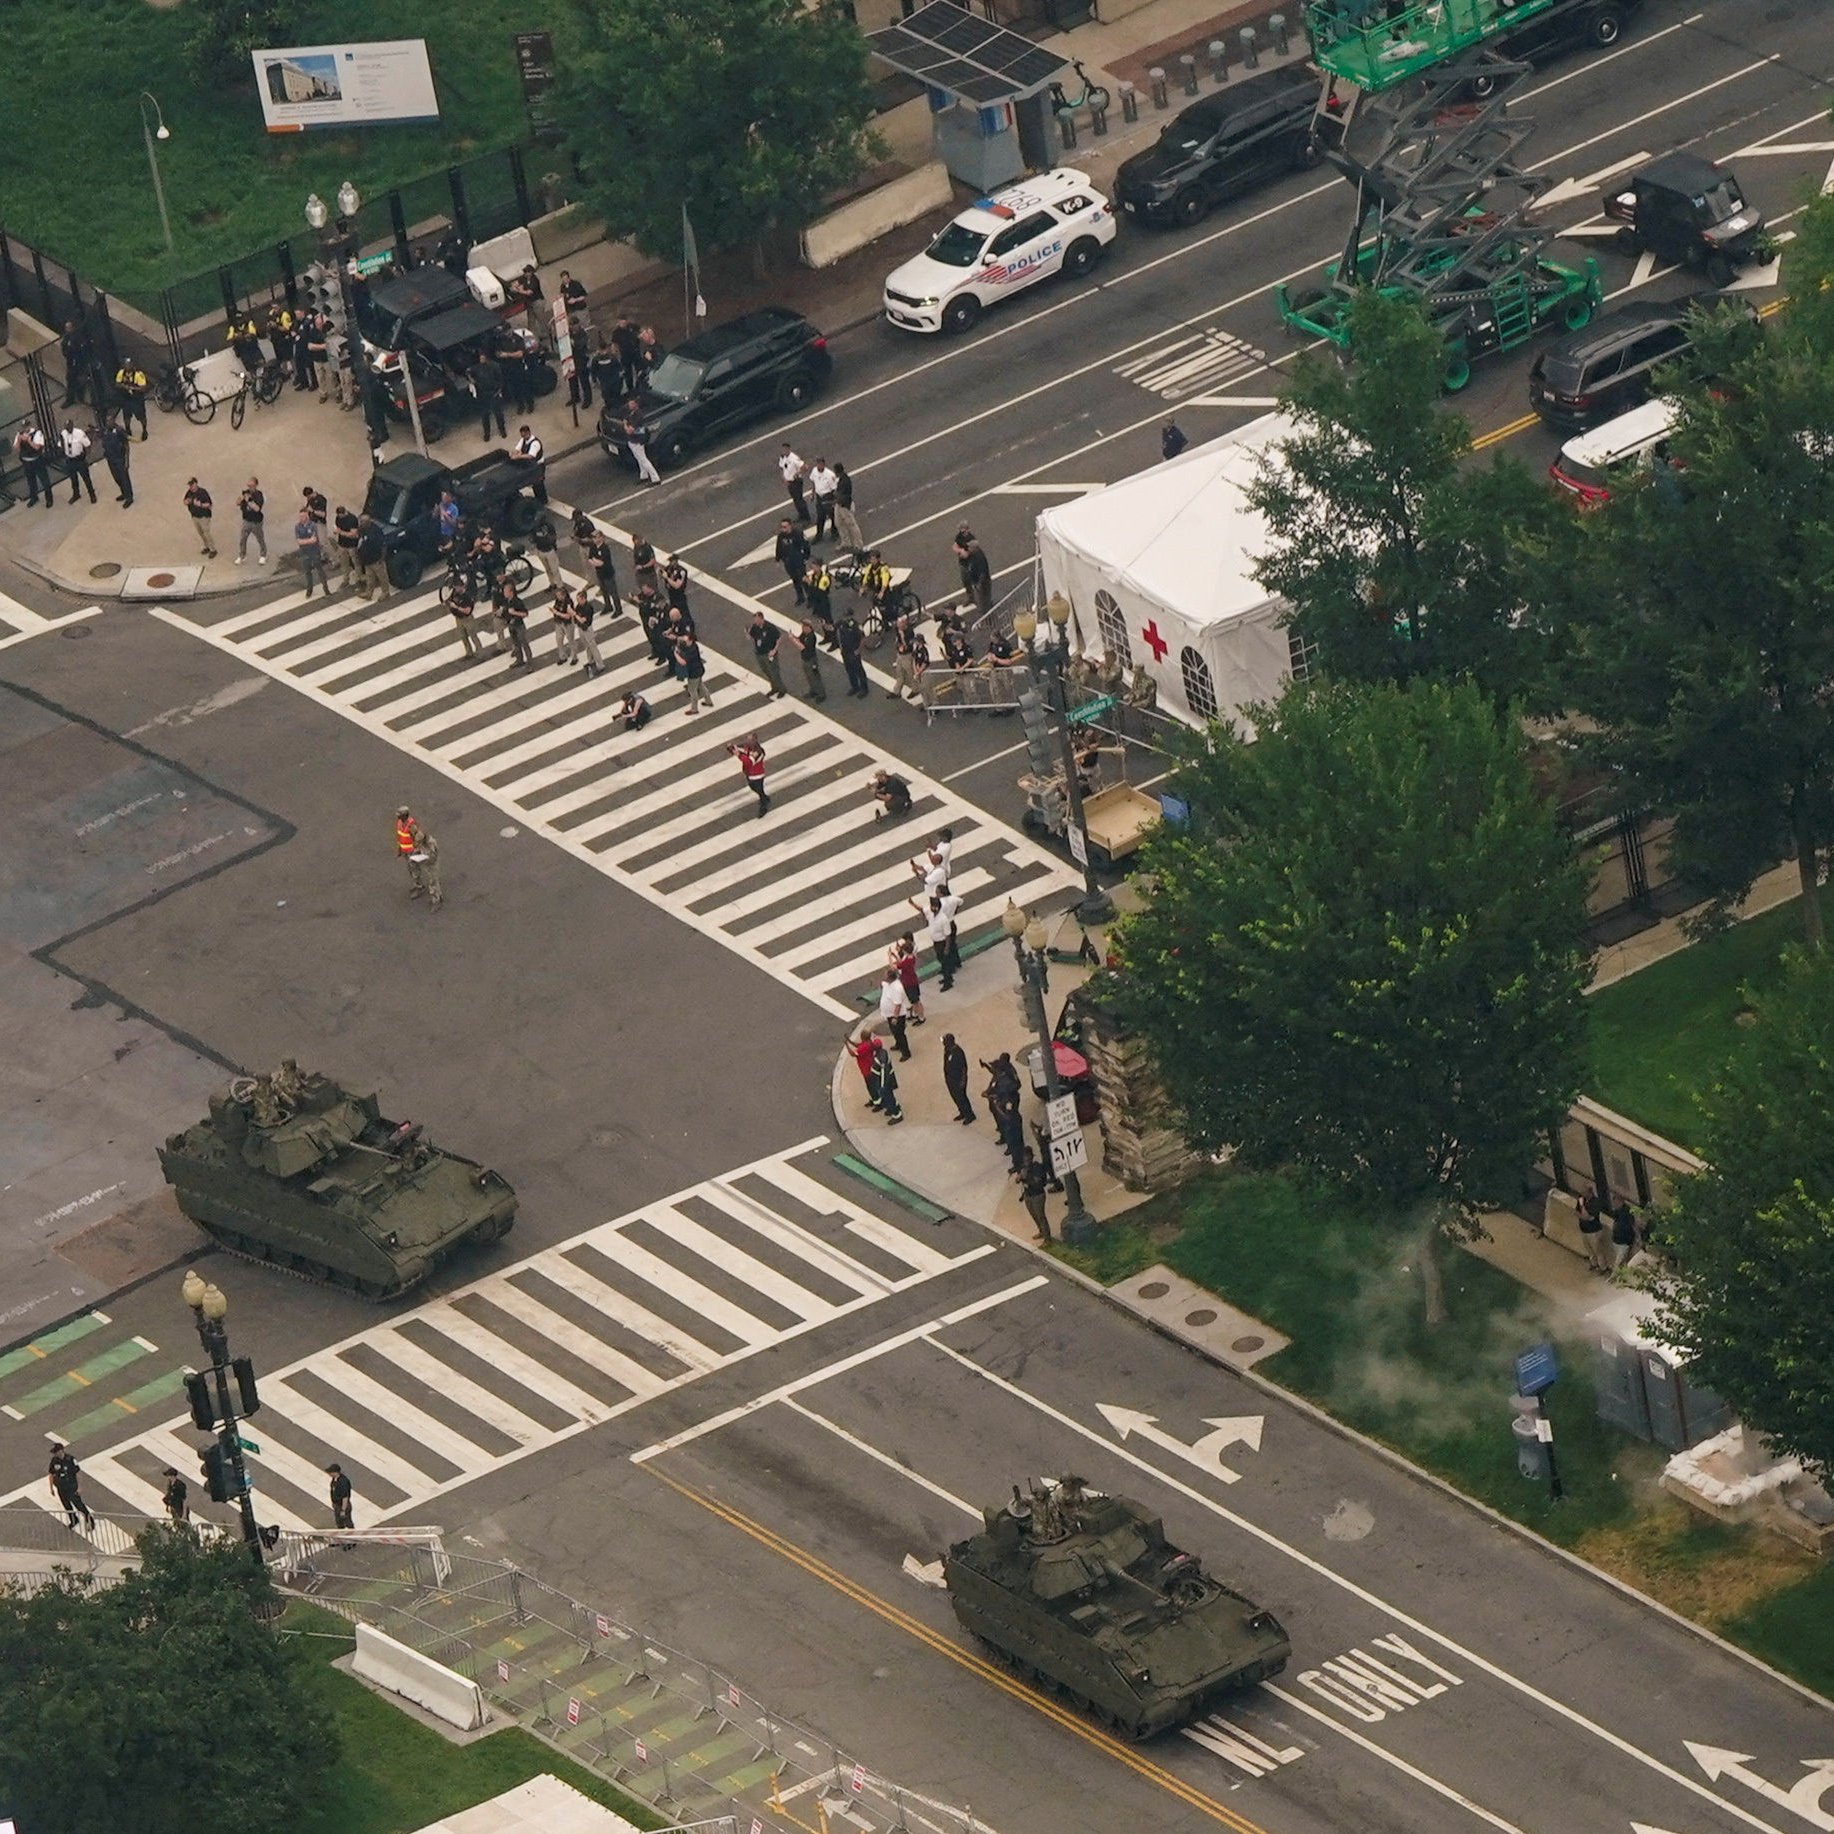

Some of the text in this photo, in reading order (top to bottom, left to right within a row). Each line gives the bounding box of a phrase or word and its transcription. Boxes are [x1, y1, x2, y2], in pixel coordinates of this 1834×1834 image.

[1061, 197, 1084, 214] K-9
[1007, 240, 1063, 274] POLICE
[1296, 1633, 1465, 1722] ONLY
